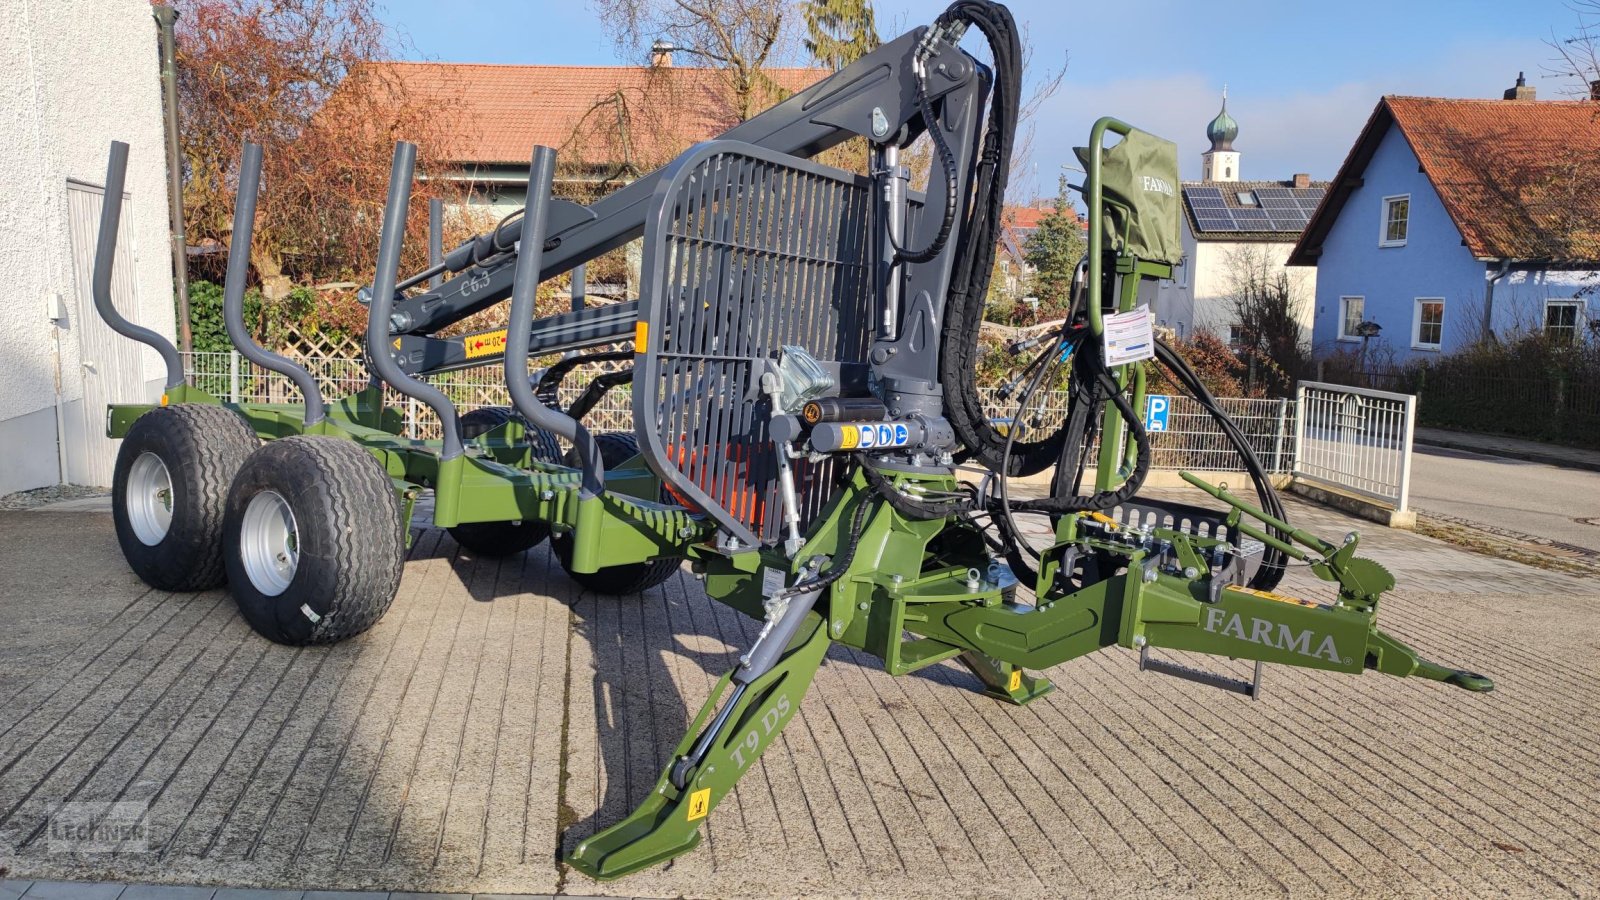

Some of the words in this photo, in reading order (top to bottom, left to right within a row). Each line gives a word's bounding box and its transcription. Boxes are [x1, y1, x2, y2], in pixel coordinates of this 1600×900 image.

[461, 270, 490, 297] C6.3
[492, 336, 501, 347] 20
[1150, 398, 1166, 420] P
[730, 730, 759, 770] T9
[761, 694, 790, 736] DS
